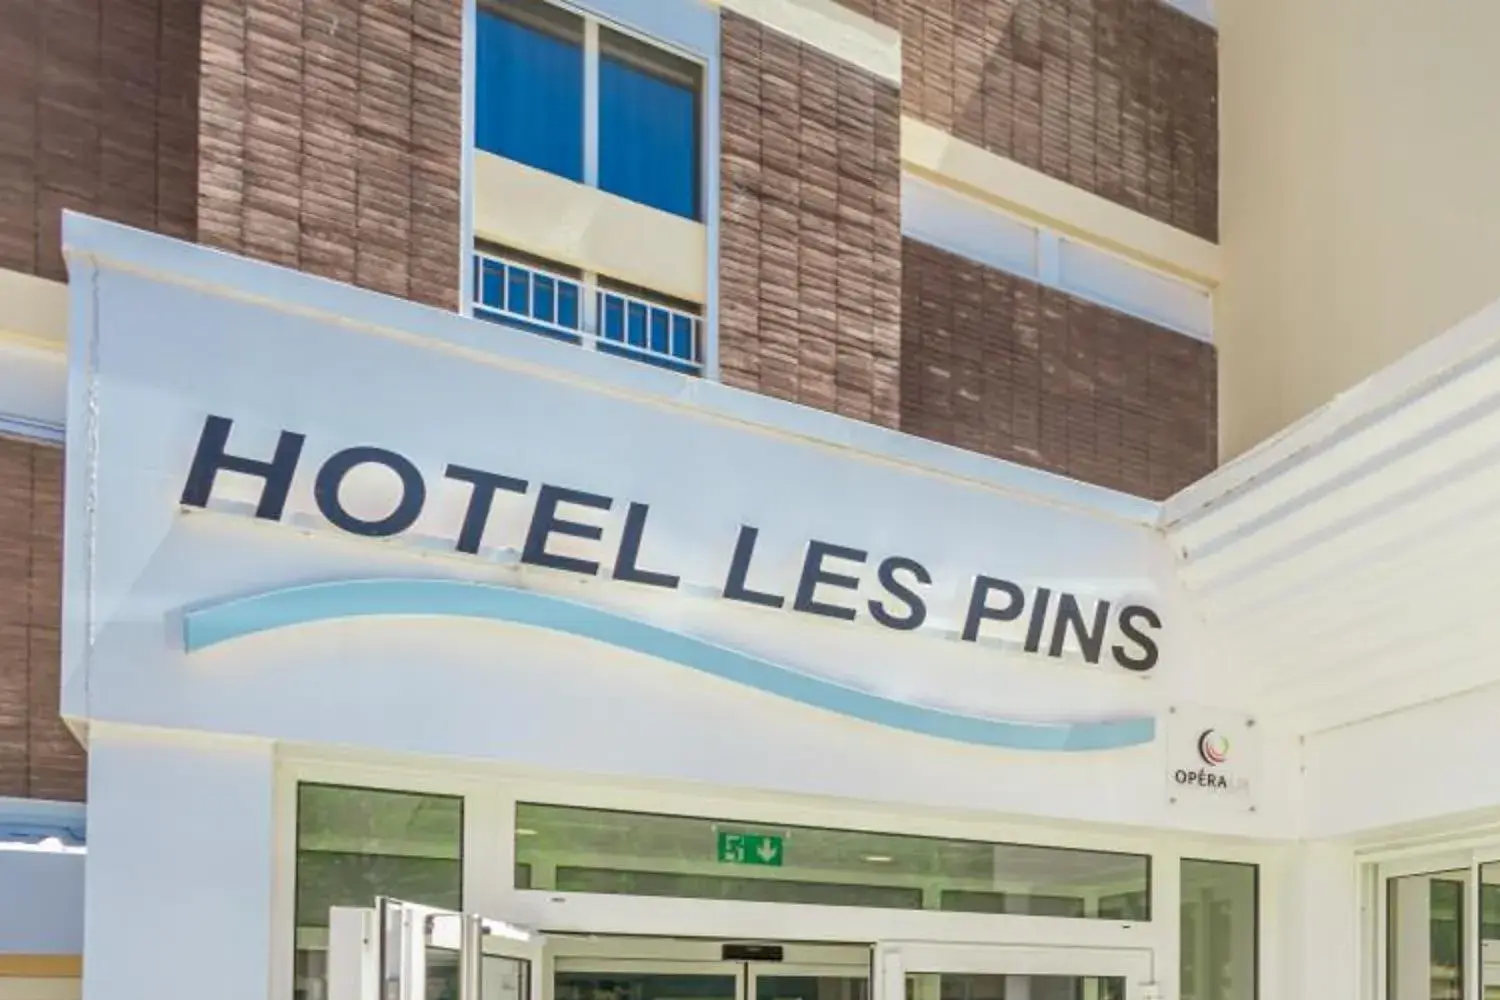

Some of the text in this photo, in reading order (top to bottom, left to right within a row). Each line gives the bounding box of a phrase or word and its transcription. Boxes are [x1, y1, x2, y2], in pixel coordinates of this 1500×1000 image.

[179, 413, 1163, 672] HOTEL LES PINS
